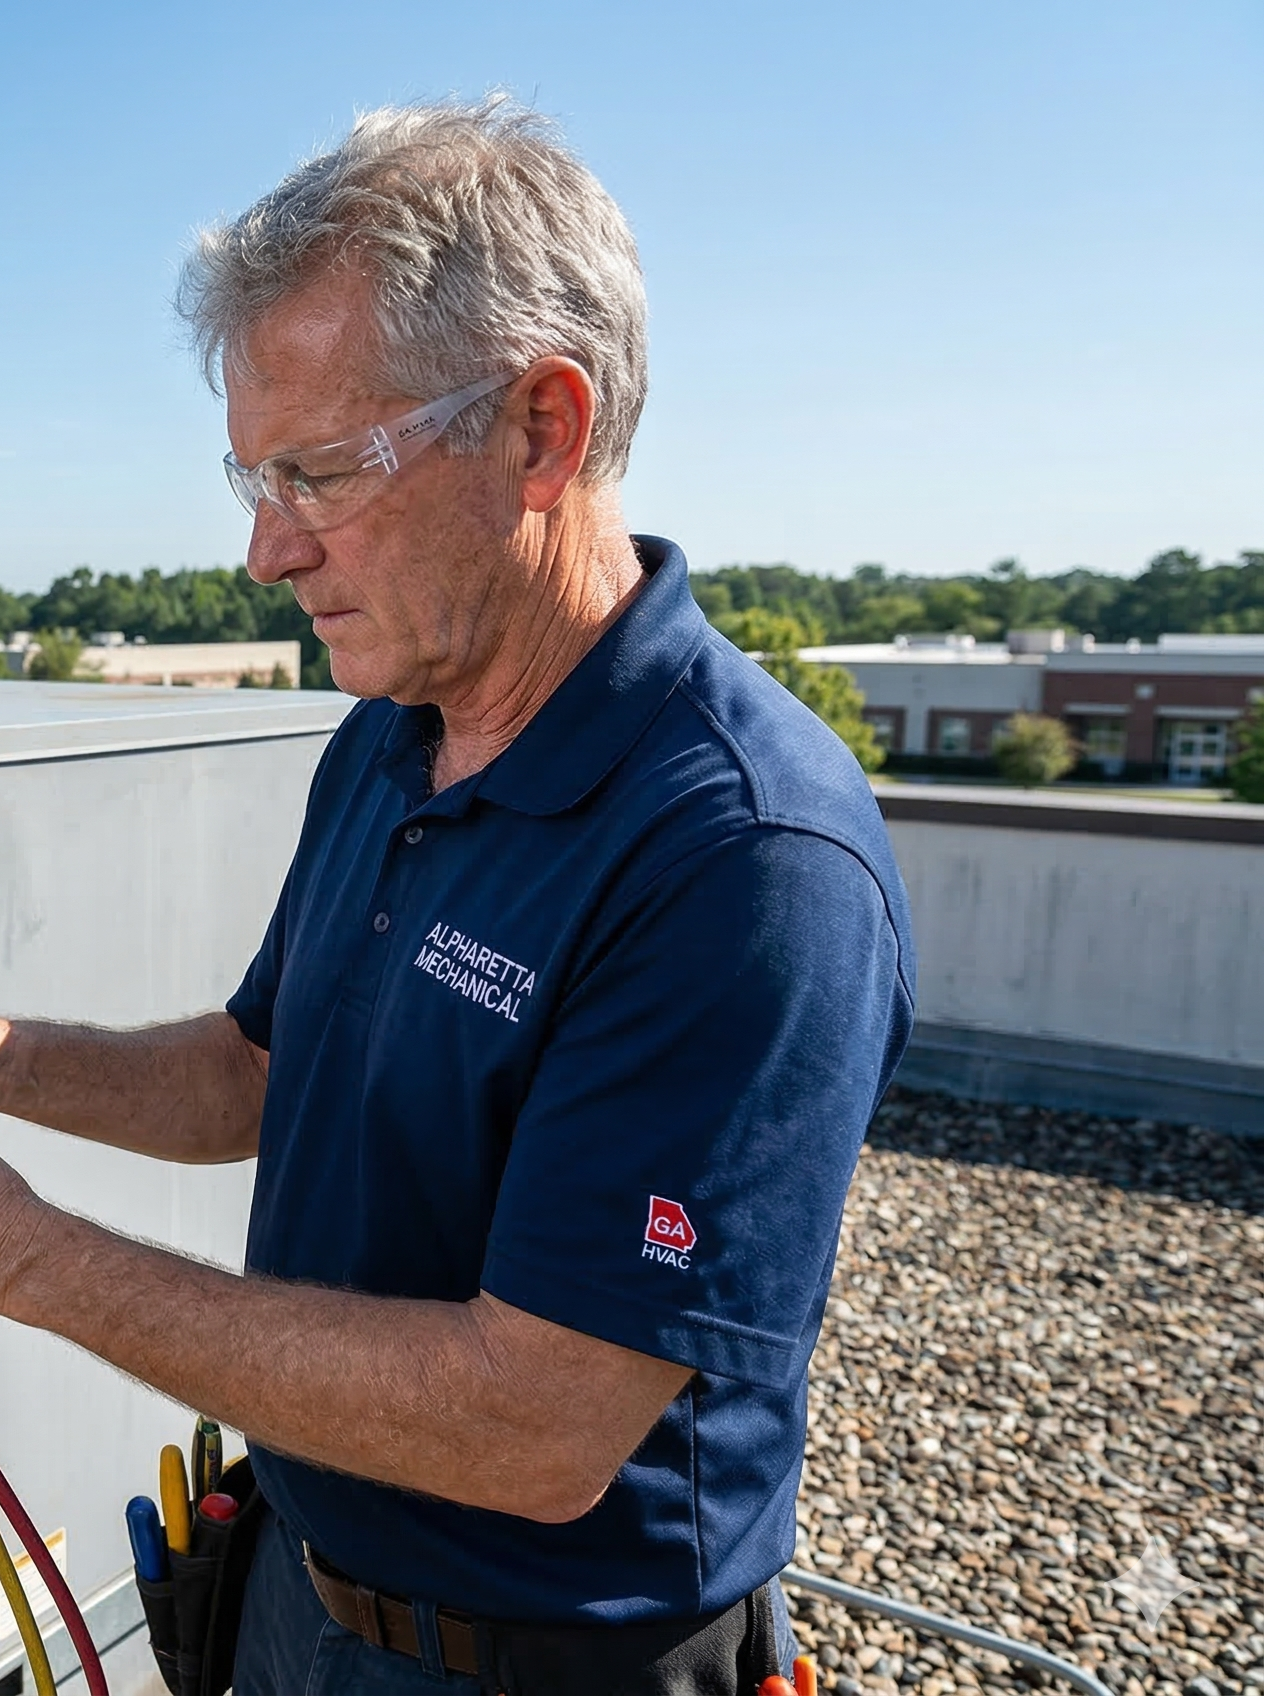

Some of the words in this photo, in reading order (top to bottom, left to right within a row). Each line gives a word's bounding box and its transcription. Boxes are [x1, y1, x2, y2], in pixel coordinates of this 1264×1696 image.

[413, 945, 521, 1023] MECHANICAL
[425, 921, 536, 997] ALPHARETTA
[653, 1216, 686, 1241] GA
[641, 1243, 692, 1270] HVAC
